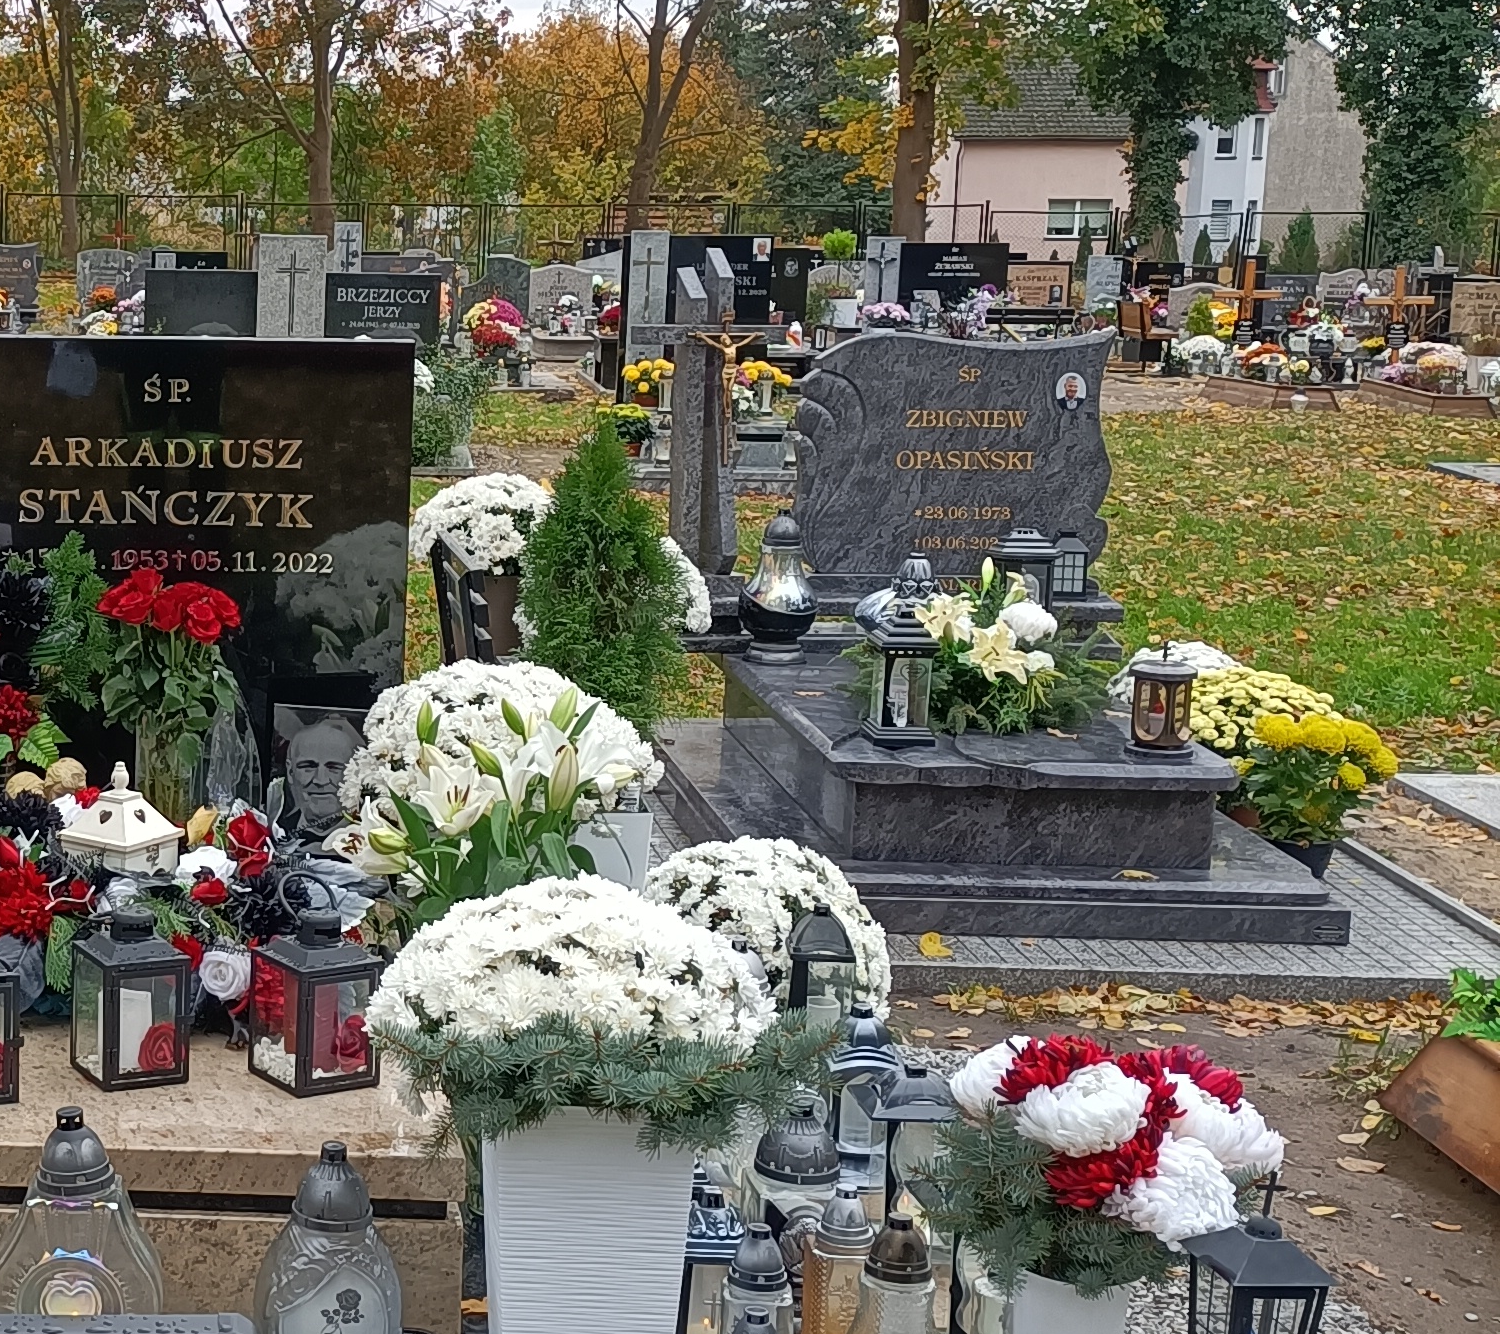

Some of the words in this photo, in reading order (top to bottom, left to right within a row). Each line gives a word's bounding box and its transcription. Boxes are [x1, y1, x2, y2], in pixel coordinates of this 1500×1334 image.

[336, 287, 431, 304] BRZEZICCY
[362, 305, 402, 320] JERZY
[905, 409, 1029, 429] ZBIGNIEW
[29, 435, 303, 470] ARKADIUSZ
[896, 446, 1035, 470] OPASIŃSKI
[18, 485, 314, 529] STAŃCZYK
[922, 535, 999, 550] 03.06.202
